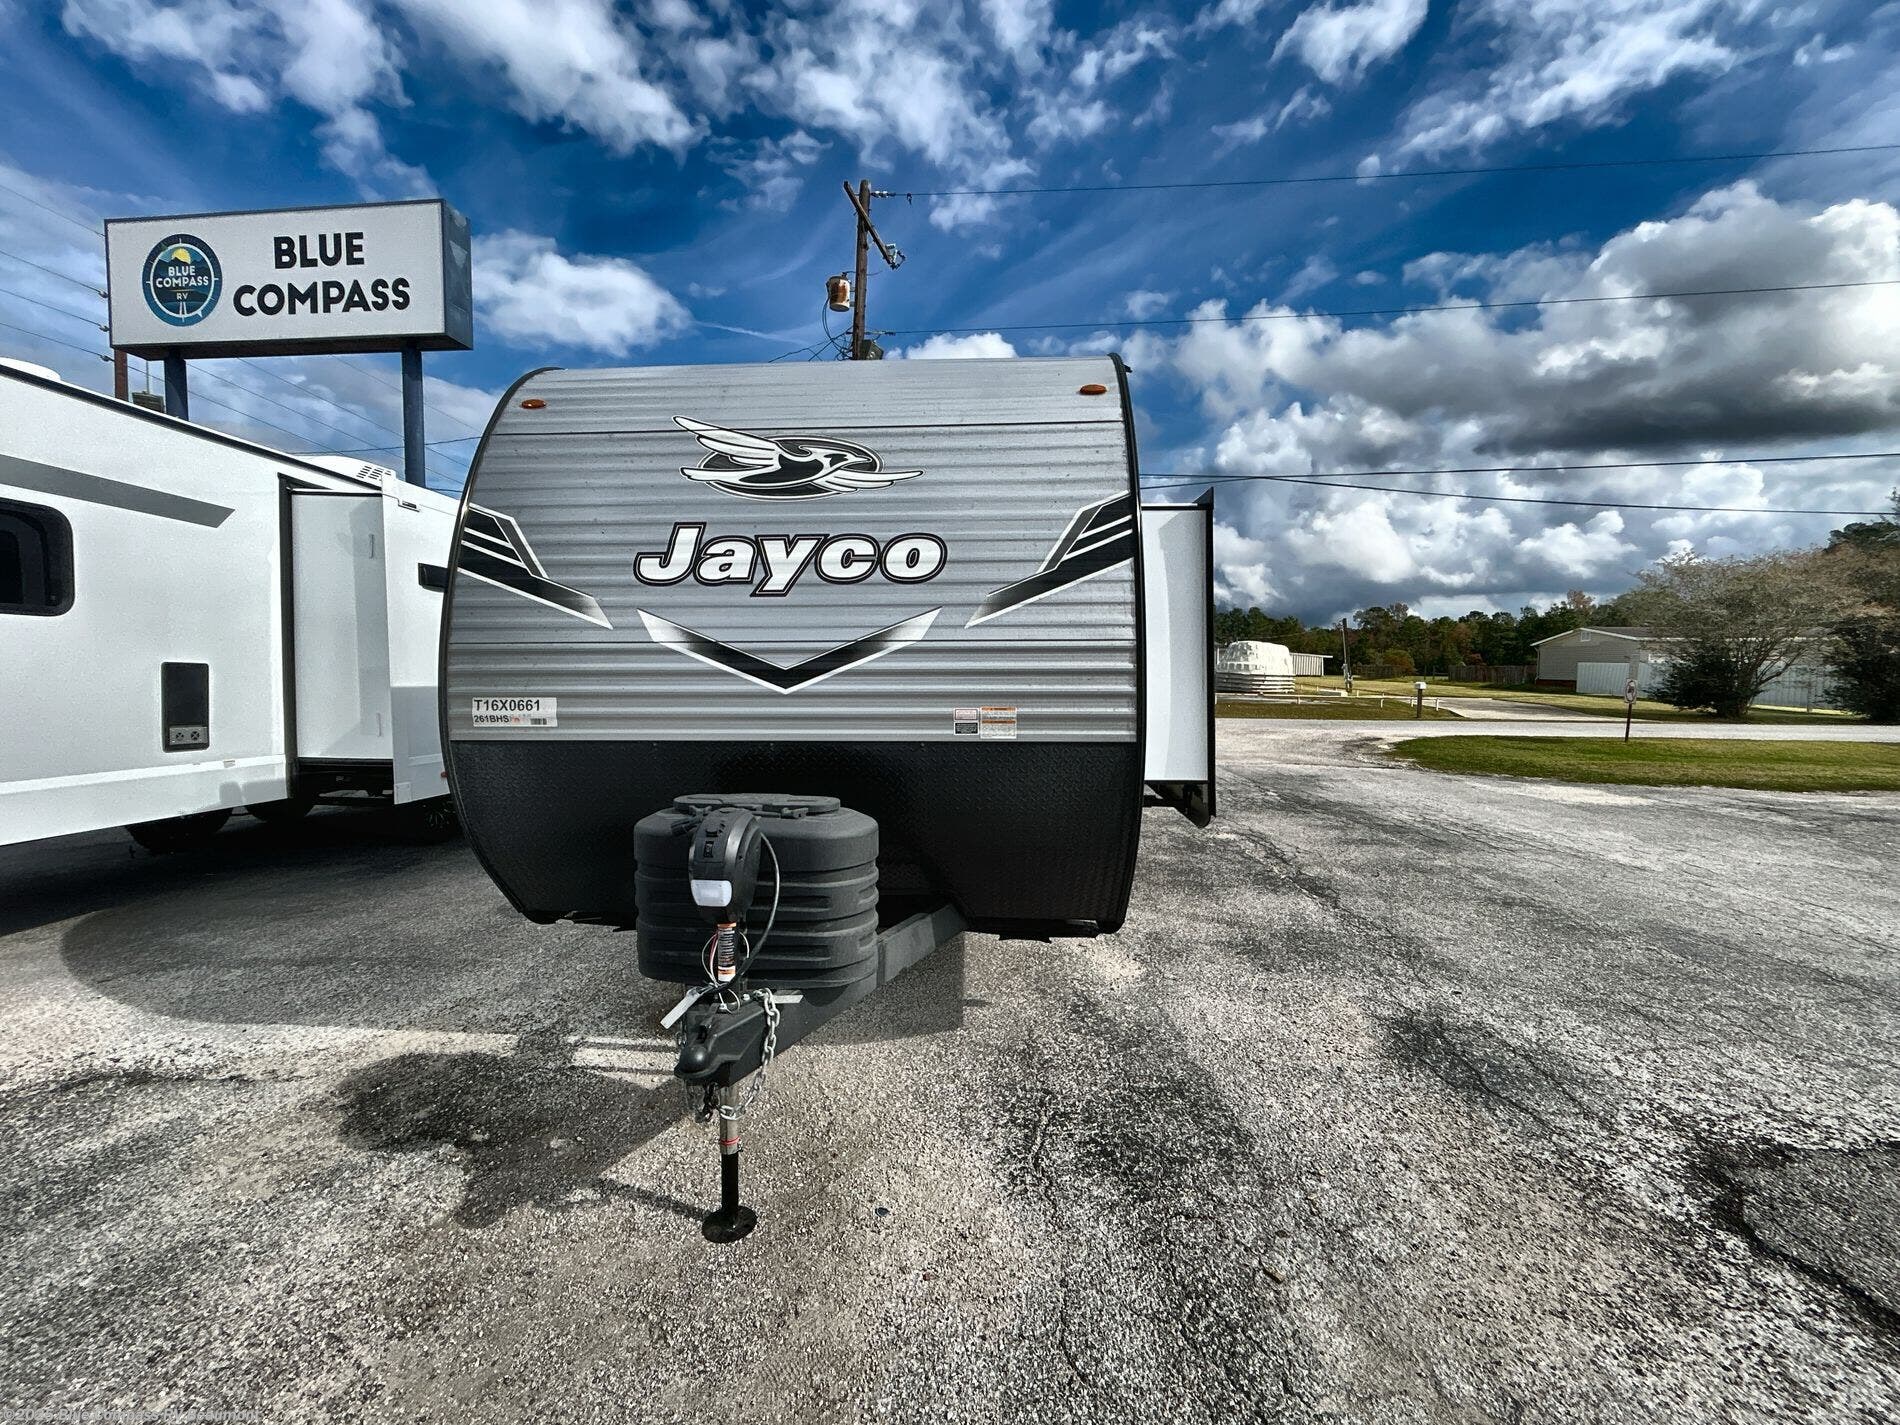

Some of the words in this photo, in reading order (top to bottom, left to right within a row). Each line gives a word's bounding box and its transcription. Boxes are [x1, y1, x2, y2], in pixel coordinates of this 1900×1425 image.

[273, 231, 365, 269] BLUE
[168, 265, 196, 277] BLUE
[155, 275, 210, 288] COMPASS
[176, 292, 189, 300] RV
[233, 277, 411, 317] COMPASS
[632, 521, 948, 597] Jayco
[474, 699, 540, 711] T16X0661
[474, 714, 509, 723] 261BHS
